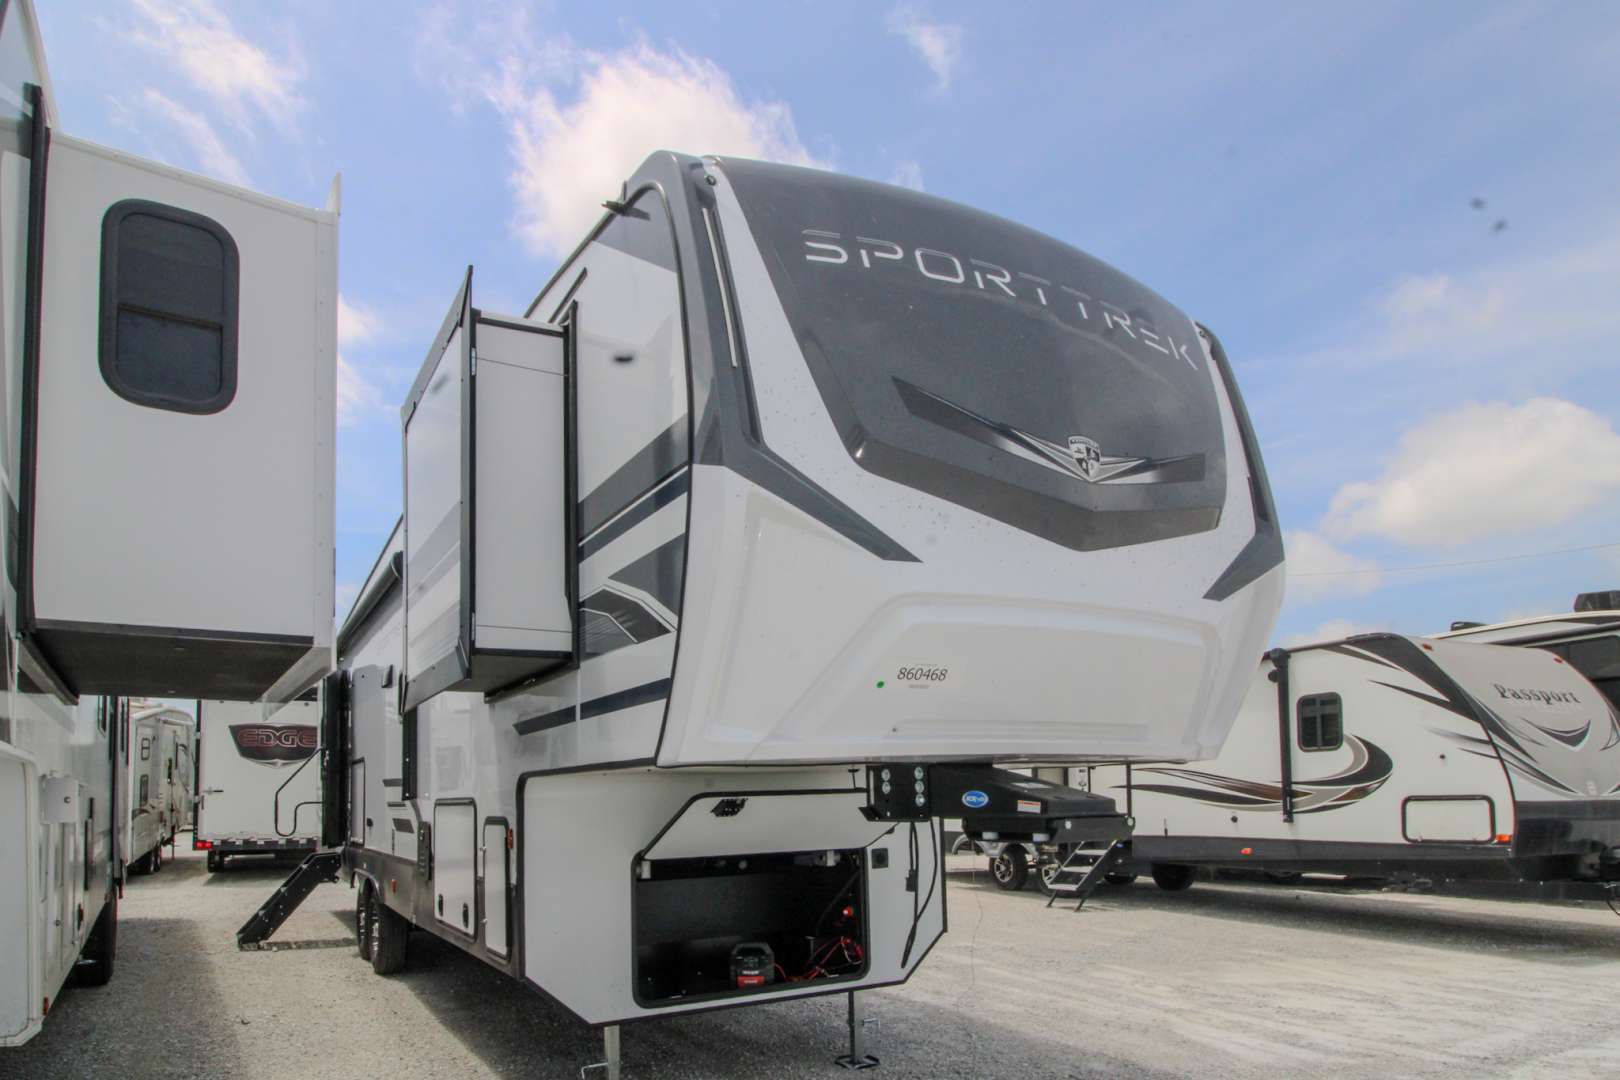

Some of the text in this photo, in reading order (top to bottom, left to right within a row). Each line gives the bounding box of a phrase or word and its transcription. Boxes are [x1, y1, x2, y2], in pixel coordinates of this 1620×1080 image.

[802, 229, 1199, 370] SPORTTREK
[897, 667, 948, 682] 860468
[1494, 684, 1581, 705] Passport
[237, 728, 318, 748] EDGE
